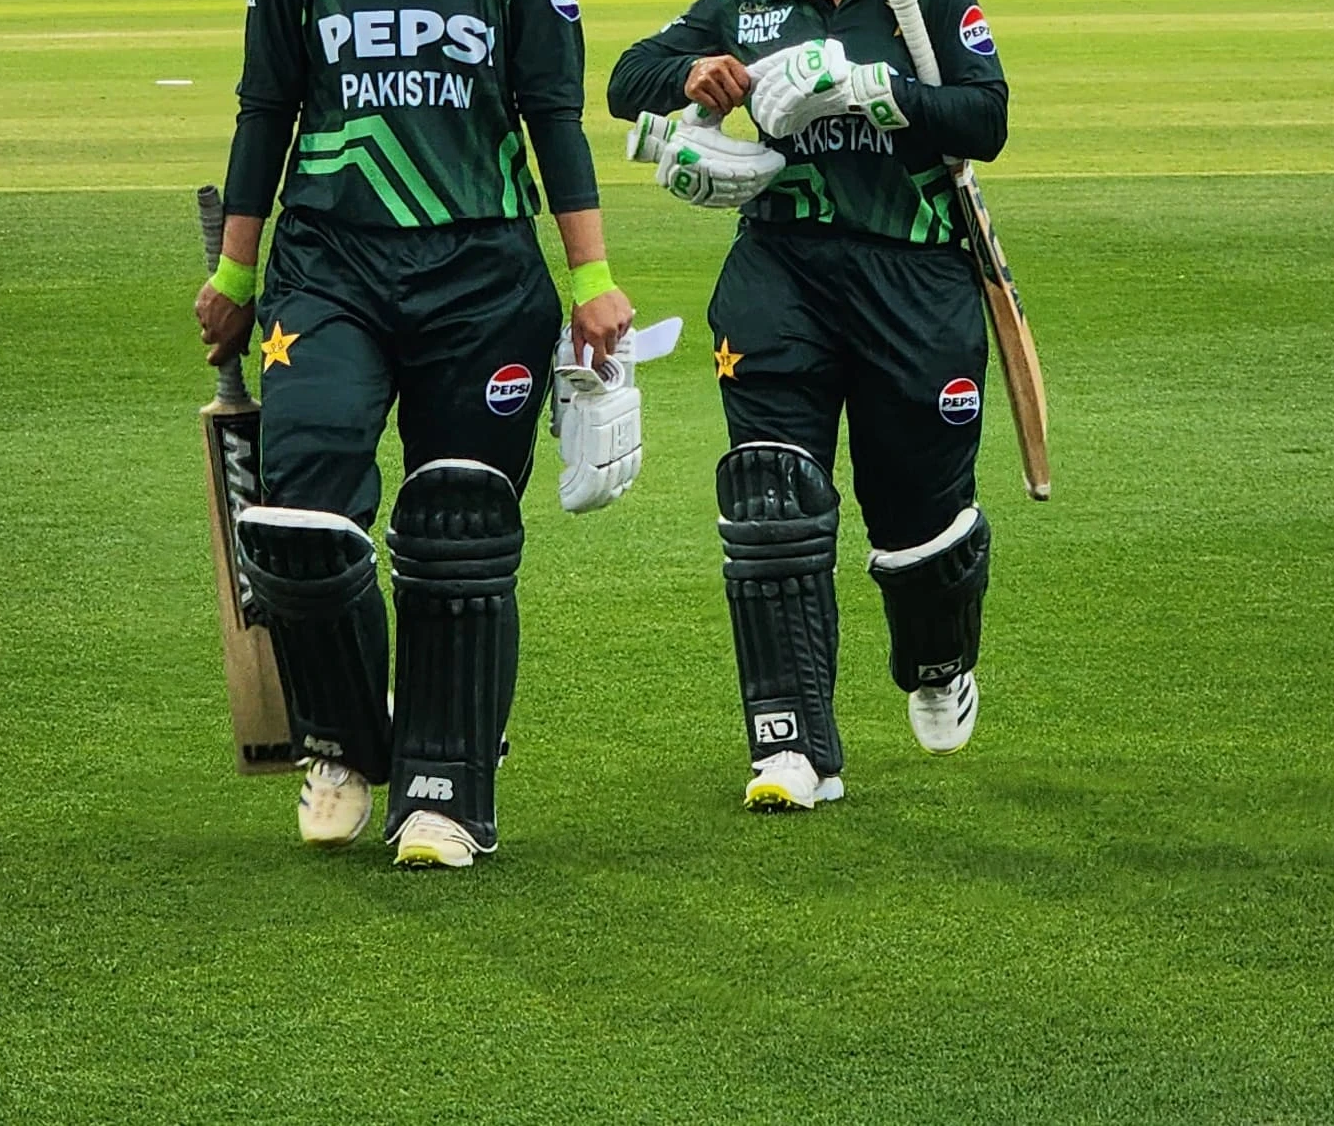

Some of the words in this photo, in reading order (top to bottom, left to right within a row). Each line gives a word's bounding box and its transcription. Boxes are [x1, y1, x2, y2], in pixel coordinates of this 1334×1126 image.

[738, 5, 794, 30] DAIRY
[737, 24, 781, 45] MILK
[341, 70, 474, 111] PAKISTAN
[792, 116, 894, 155] AKISTAN
[489, 382, 531, 395] PEPSI
[942, 396, 977, 407] PEPSI
